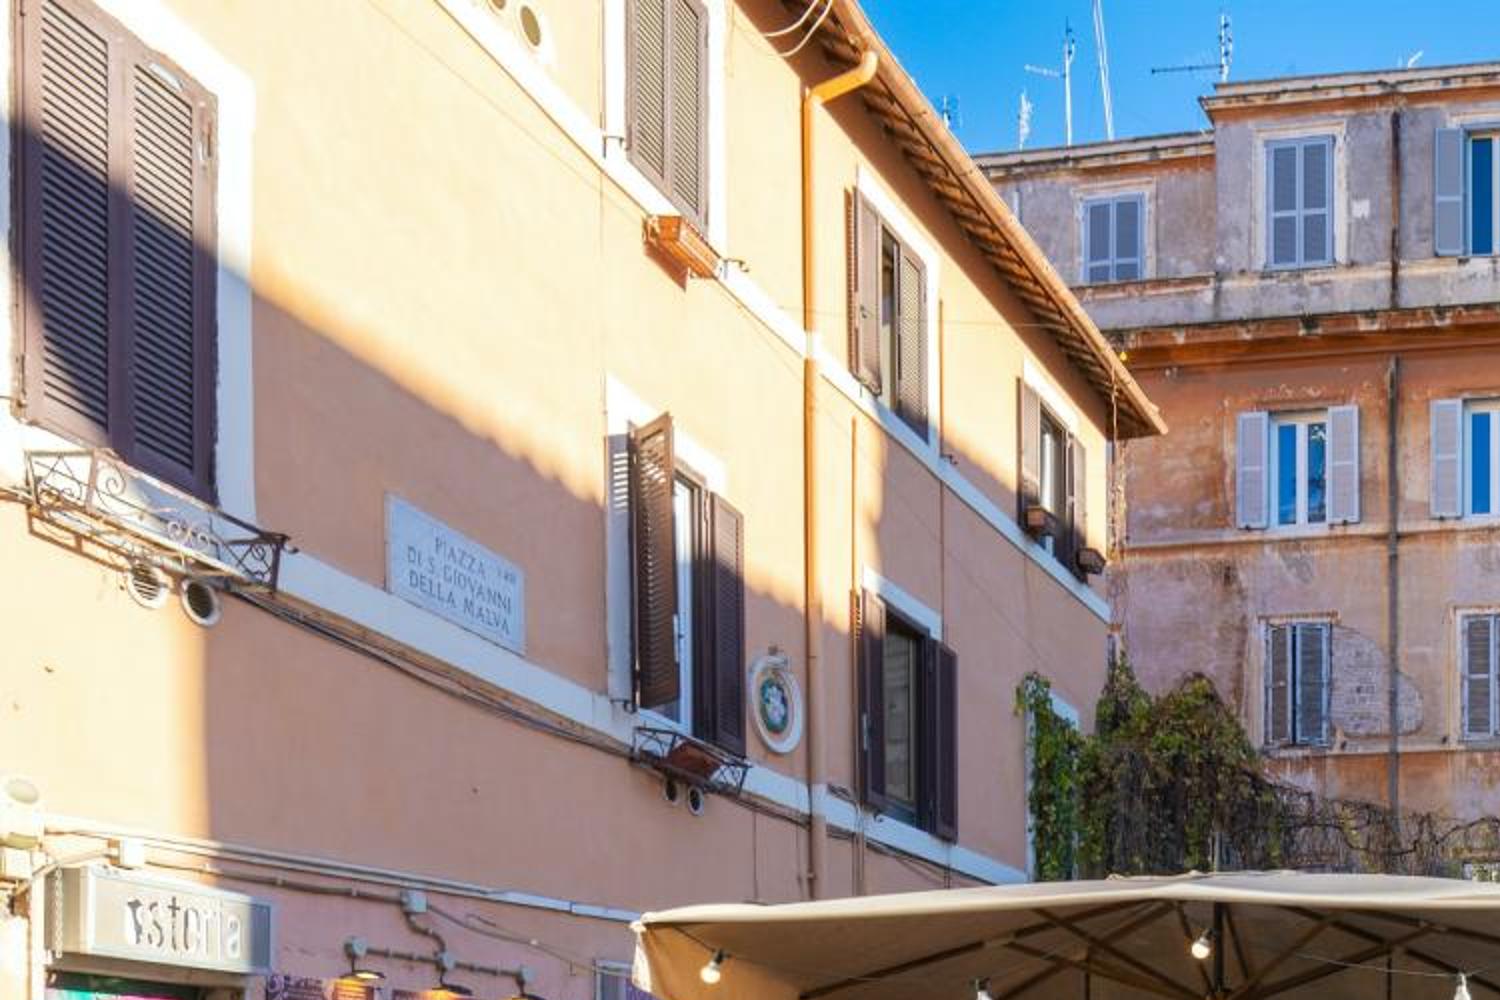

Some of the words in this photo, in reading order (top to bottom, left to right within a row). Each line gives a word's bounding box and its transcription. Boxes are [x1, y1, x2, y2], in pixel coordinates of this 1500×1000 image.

[434, 535, 486, 580] PIAZZA
[409, 569, 457, 609] DELLA
[462, 597, 511, 635] MALVA
[442, 564, 512, 615] GIOVANNI
